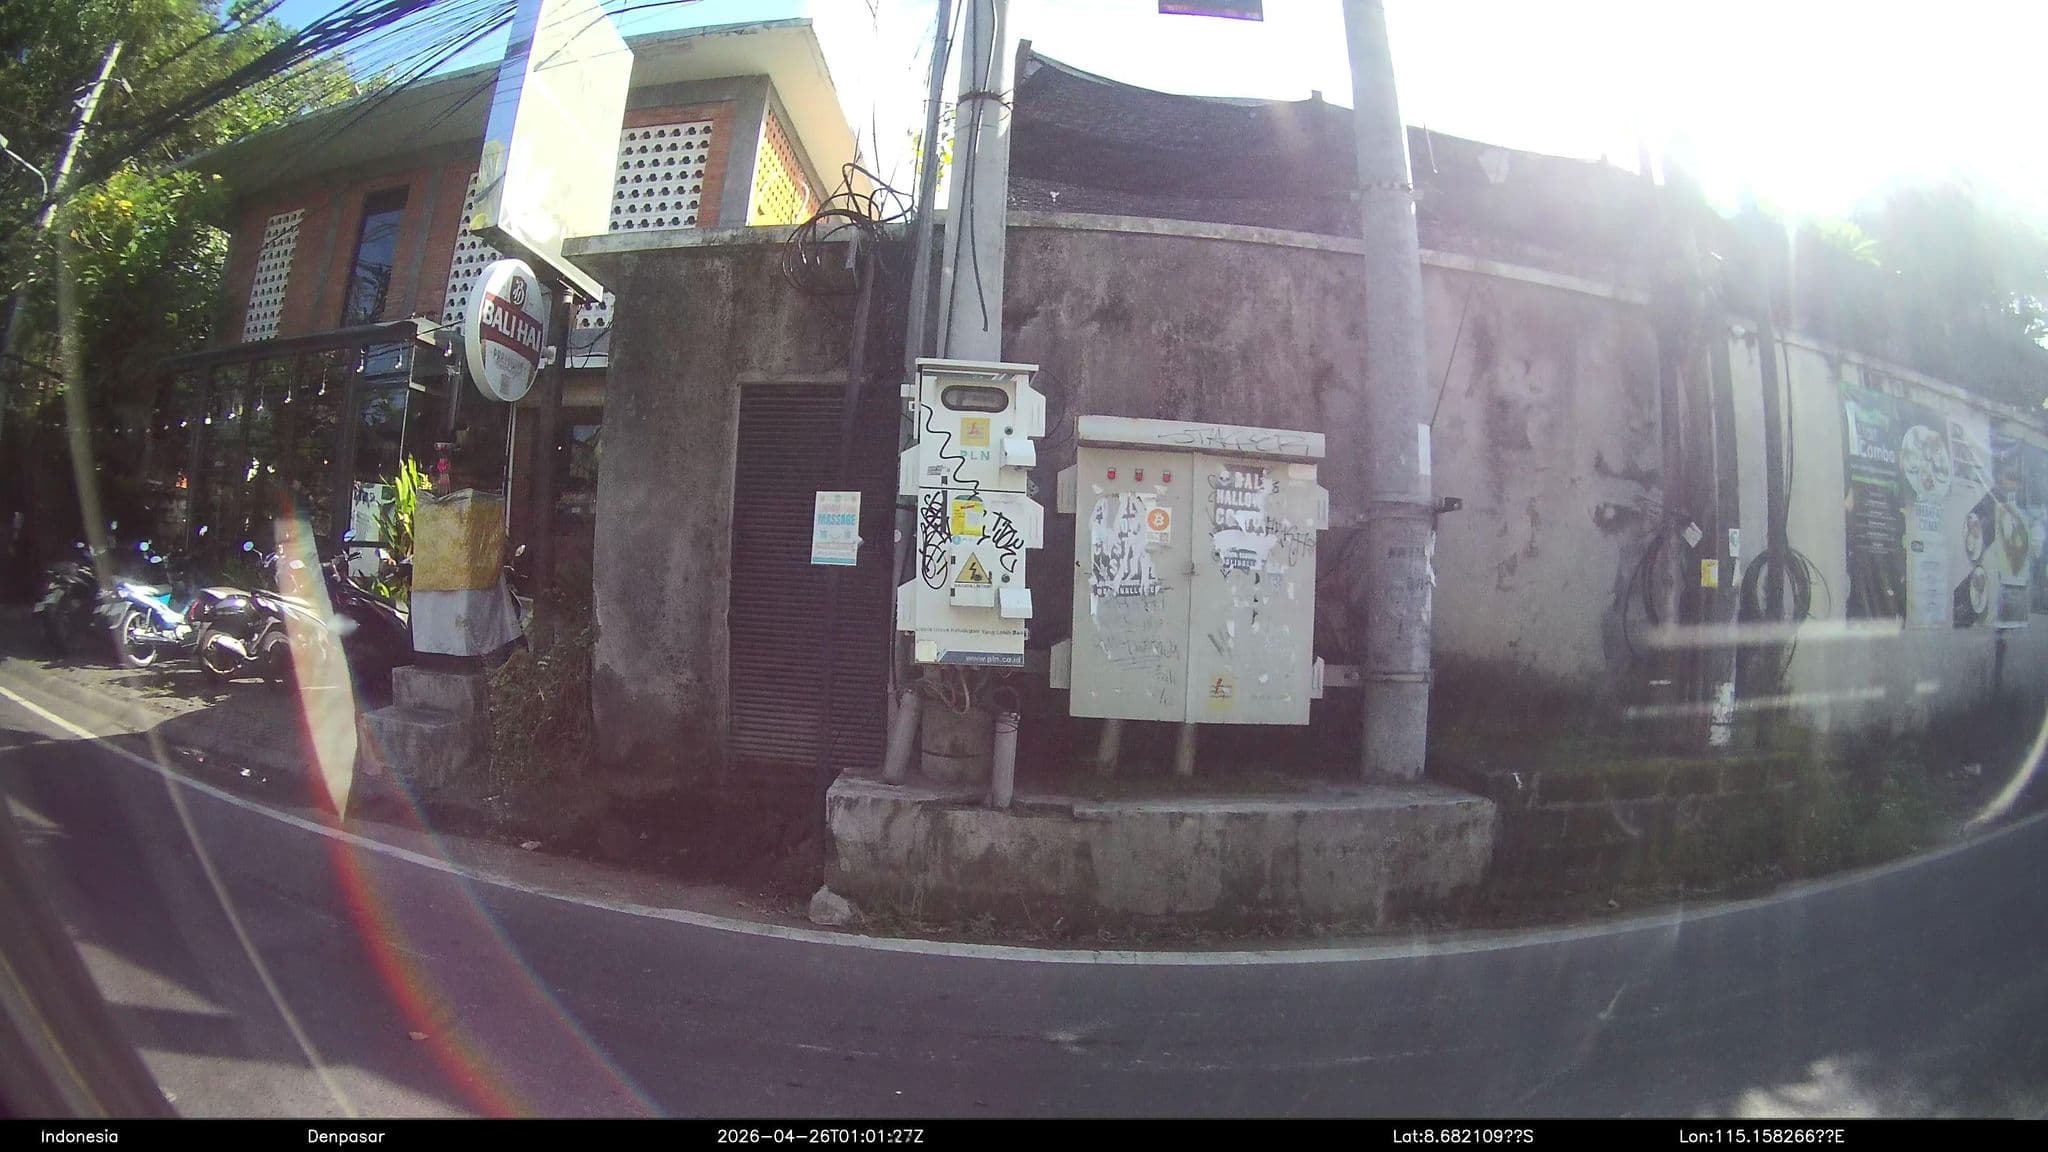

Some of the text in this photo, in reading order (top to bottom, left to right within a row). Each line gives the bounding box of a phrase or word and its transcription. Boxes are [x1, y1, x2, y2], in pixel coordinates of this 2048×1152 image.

[482, 299, 541, 352] BALI HAI
[960, 450, 990, 461] PLN
[816, 512, 857, 526] MASSAGE
[966, 655, 1021, 663] www.pln.co.id
